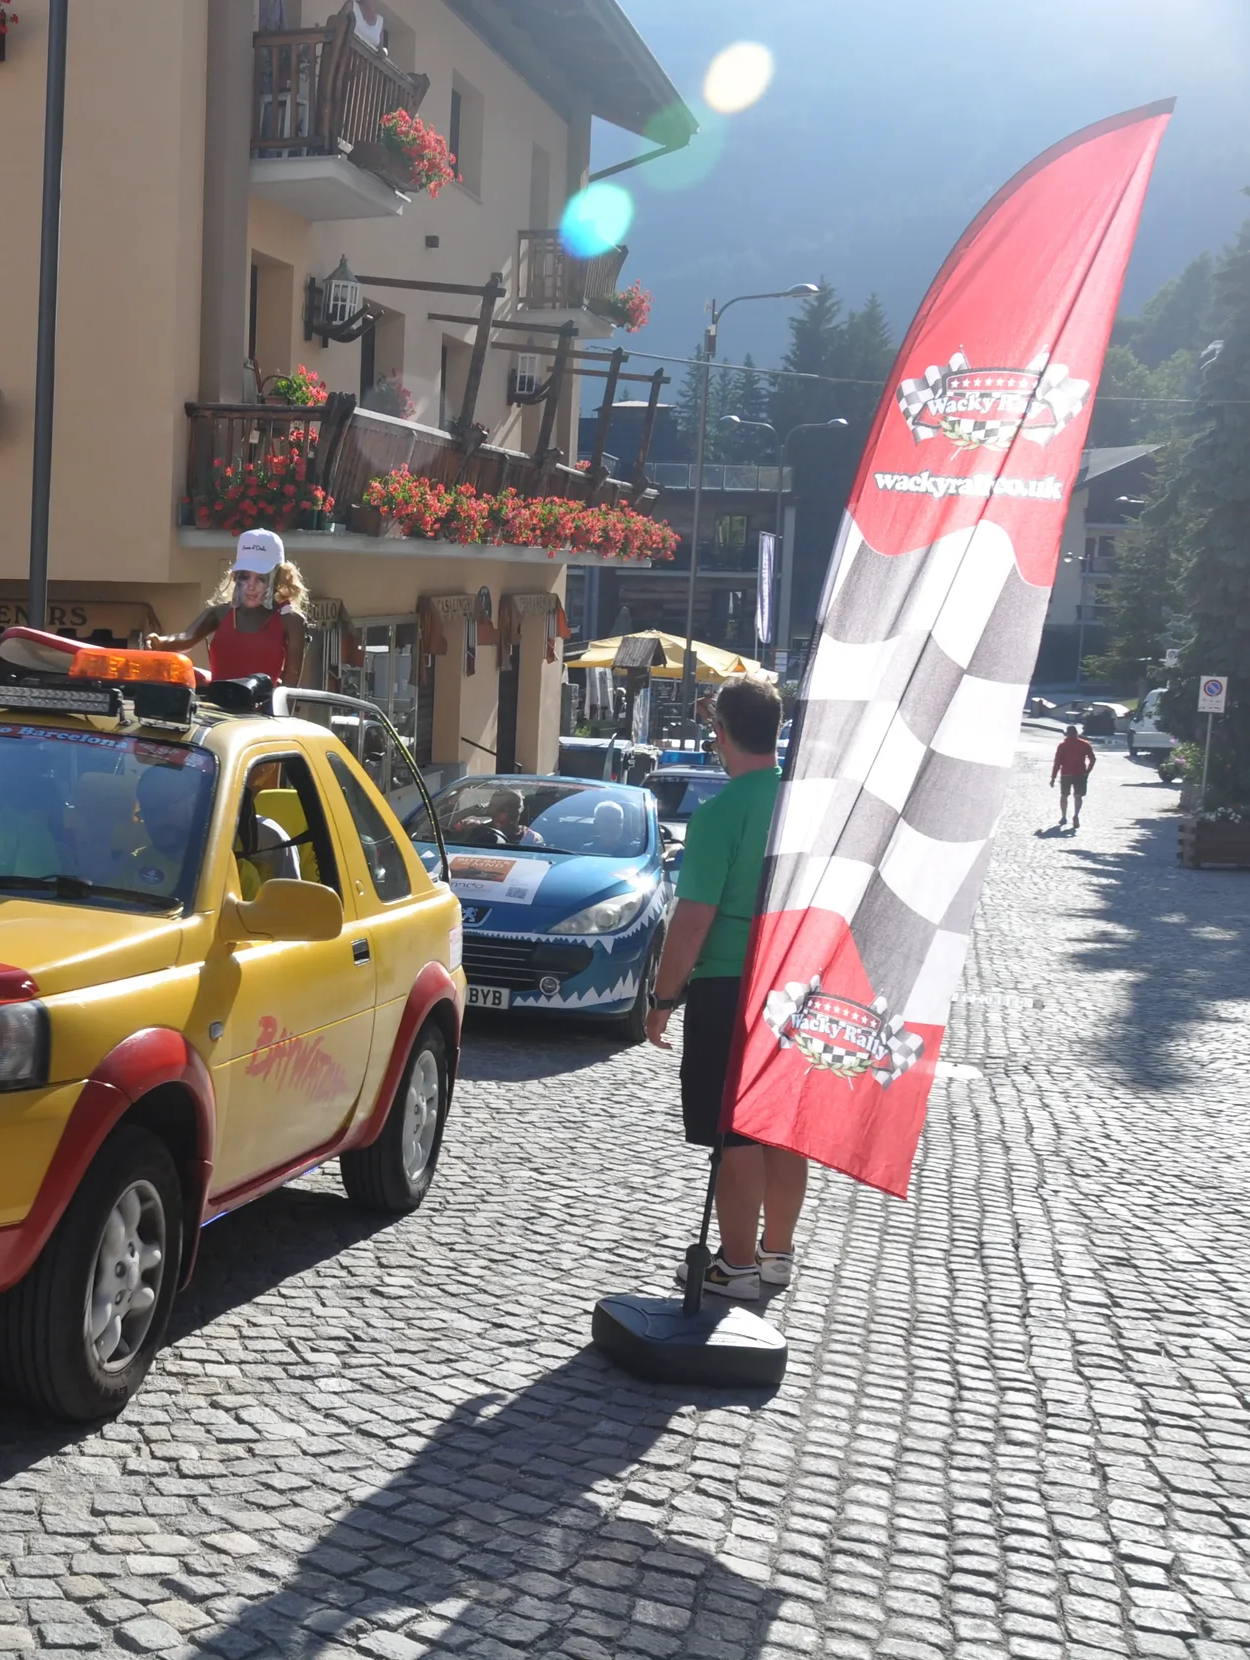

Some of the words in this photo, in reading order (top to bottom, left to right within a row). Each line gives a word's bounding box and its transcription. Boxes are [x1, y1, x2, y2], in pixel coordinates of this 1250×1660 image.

[927, 392, 998, 416] Wacky
[997, 394, 1047, 419] Ray
[874, 470, 1062, 500] wackyrallco.uk
[17, 726, 127, 749] Barcelona
[468, 987, 502, 1006] BYB
[791, 1012, 842, 1040] Wacky
[843, 1022, 888, 1061] Rally
